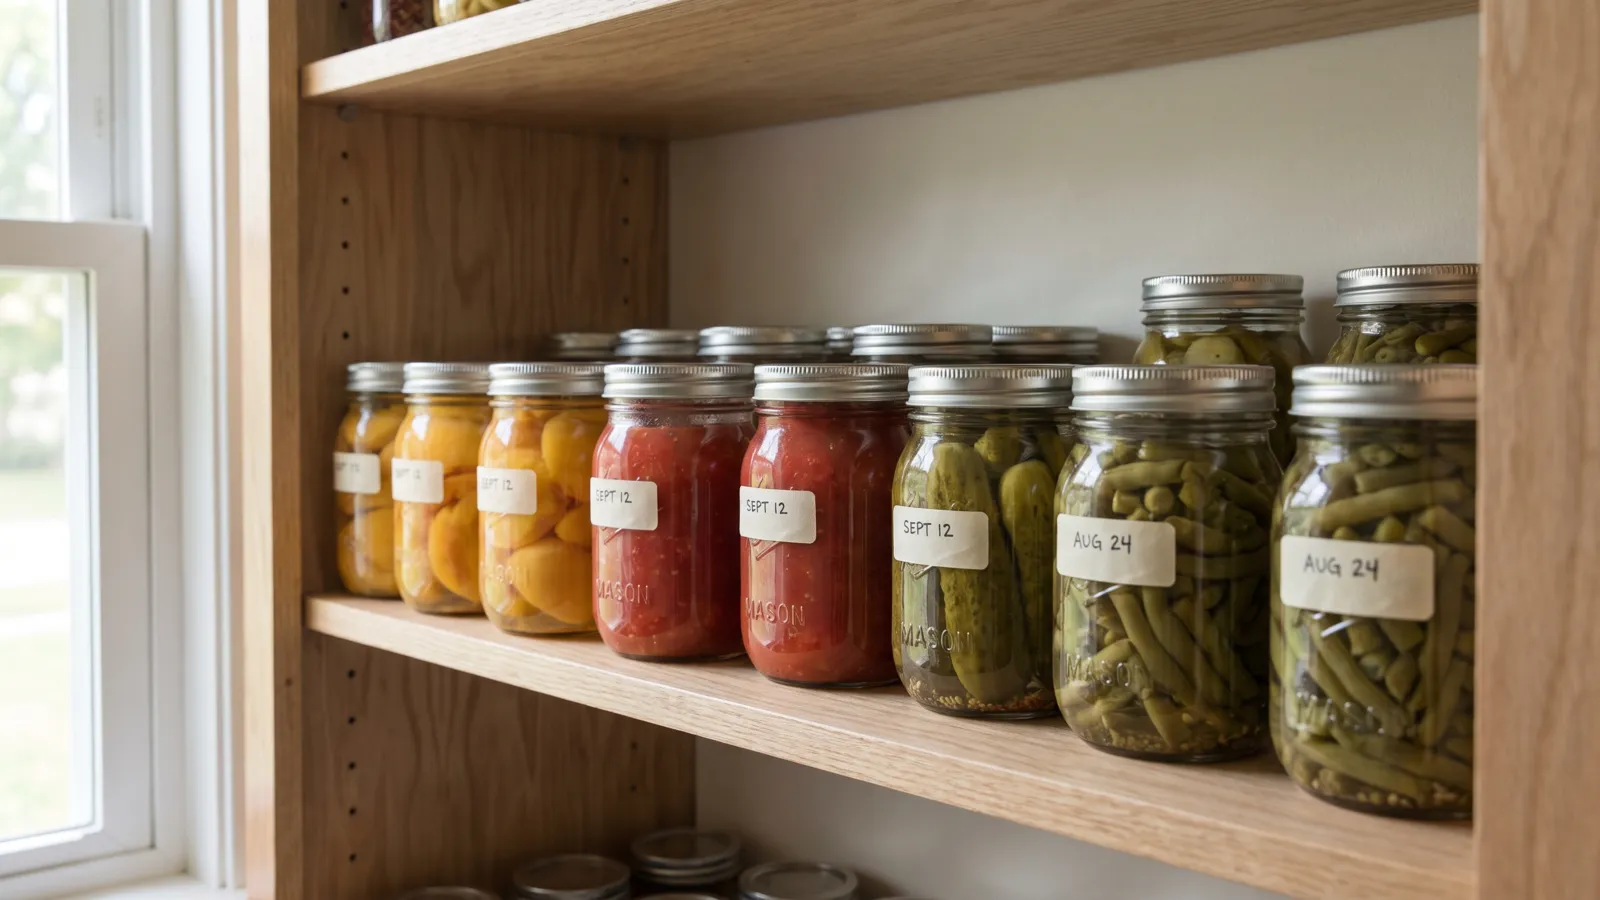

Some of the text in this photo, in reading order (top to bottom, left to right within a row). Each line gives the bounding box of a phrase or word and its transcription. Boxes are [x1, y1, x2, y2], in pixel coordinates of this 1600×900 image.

[596, 489, 633, 504] SEPT 12
[746, 499, 788, 515] SEPT 12
[903, 519, 954, 538] SEPT 12
[1073, 531, 1132, 555] AUG 24
[1303, 553, 1379, 582] AUG 24
[595, 578, 650, 605] MASON
[745, 597, 806, 627] MASON
[901, 621, 974, 654] MASON
